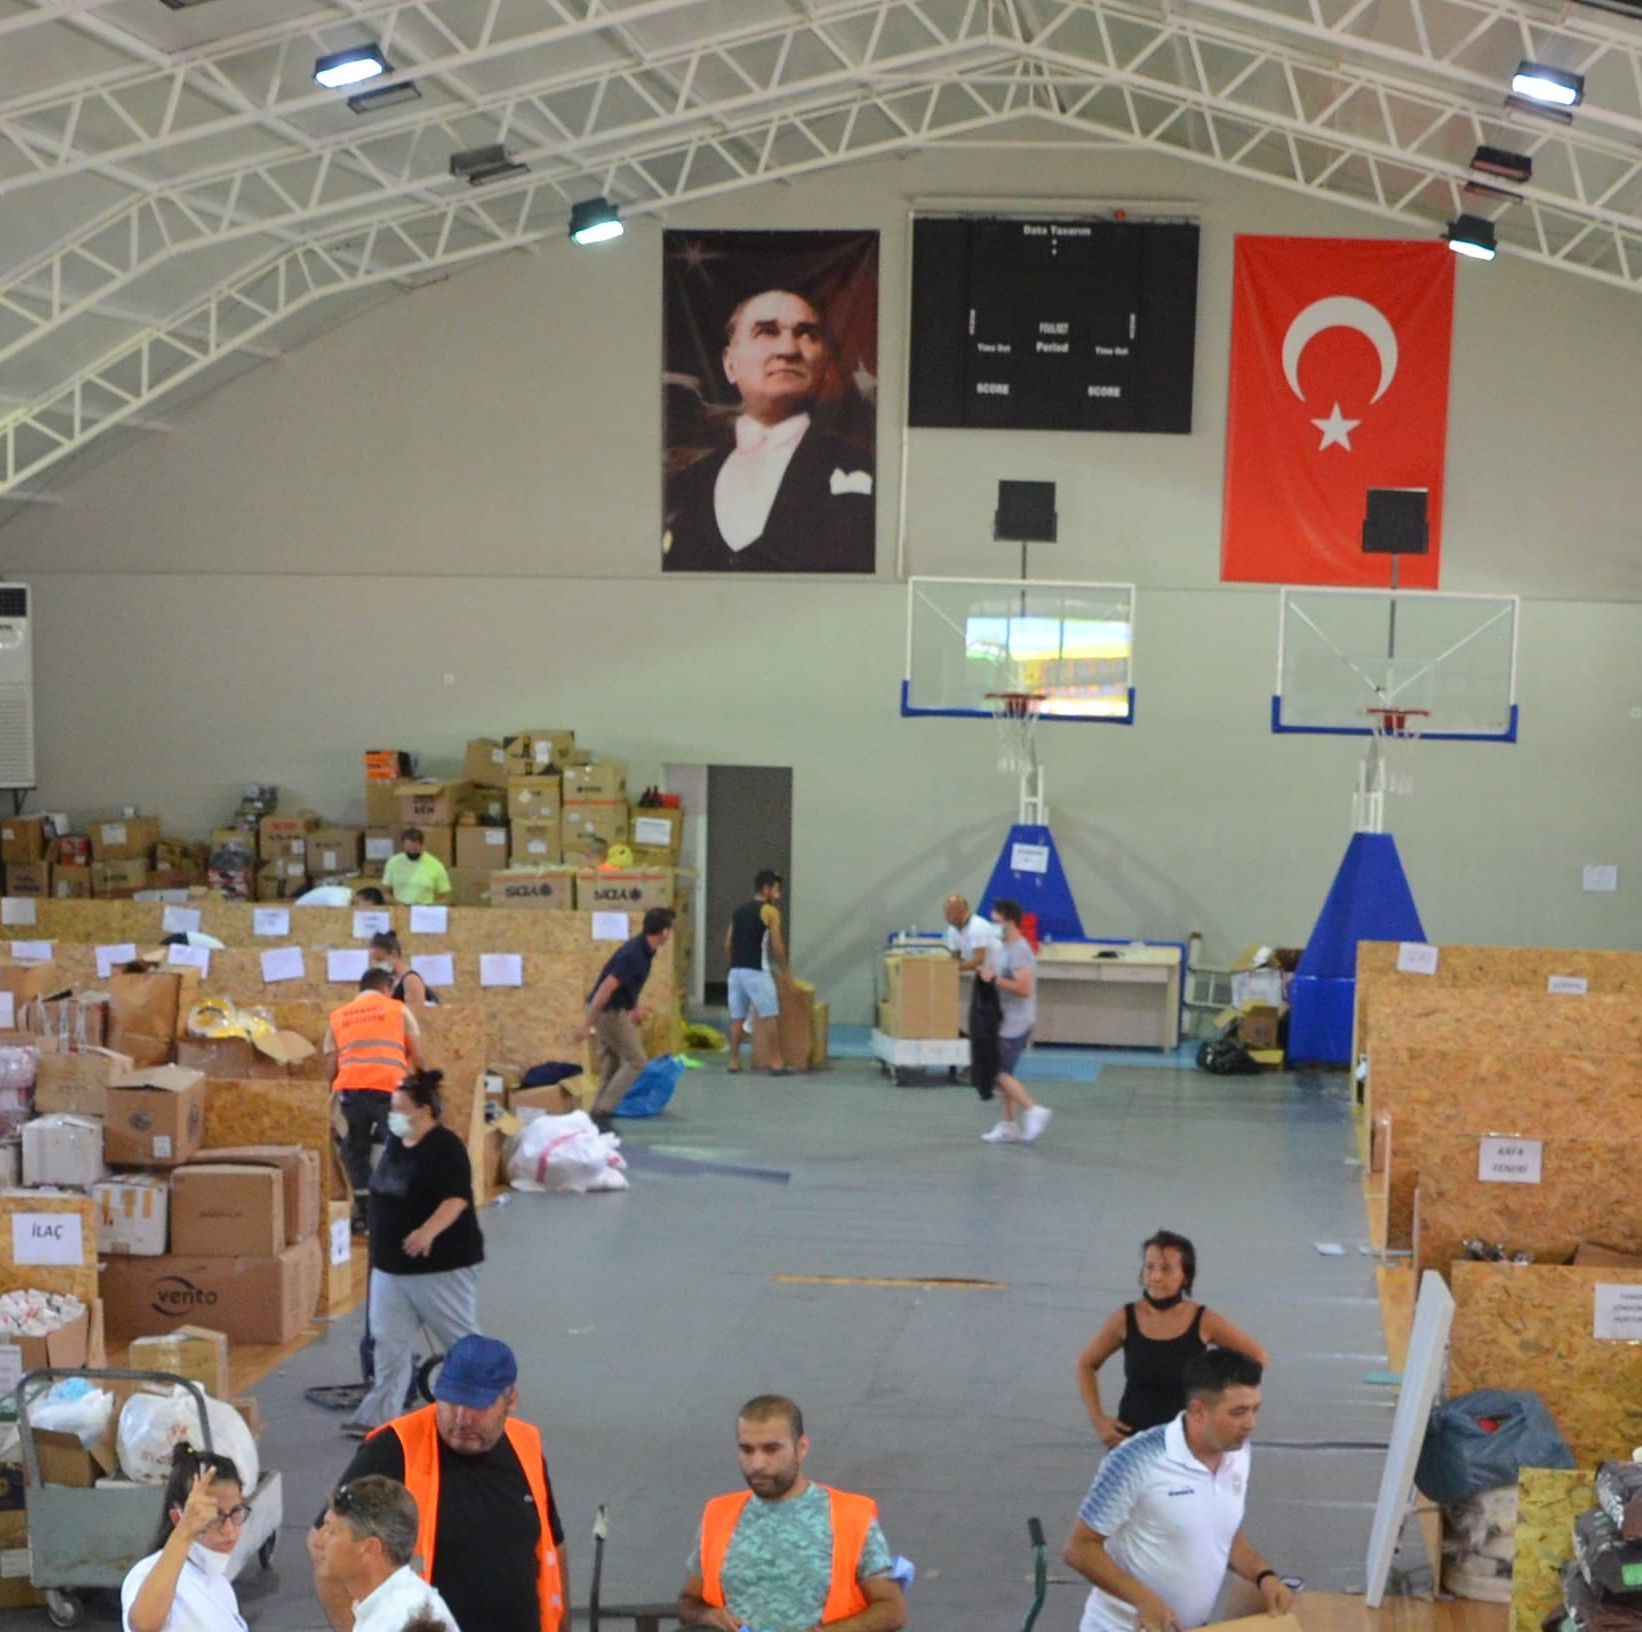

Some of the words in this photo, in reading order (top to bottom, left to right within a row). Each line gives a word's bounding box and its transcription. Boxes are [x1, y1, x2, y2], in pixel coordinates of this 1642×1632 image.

[1036, 341, 1069, 353] Period
[976, 382, 1009, 395] SCORE
[1087, 386, 1121, 397] SCORE
[31, 1220, 64, 1240] İLAÇ
[158, 1287, 219, 1306] vento
